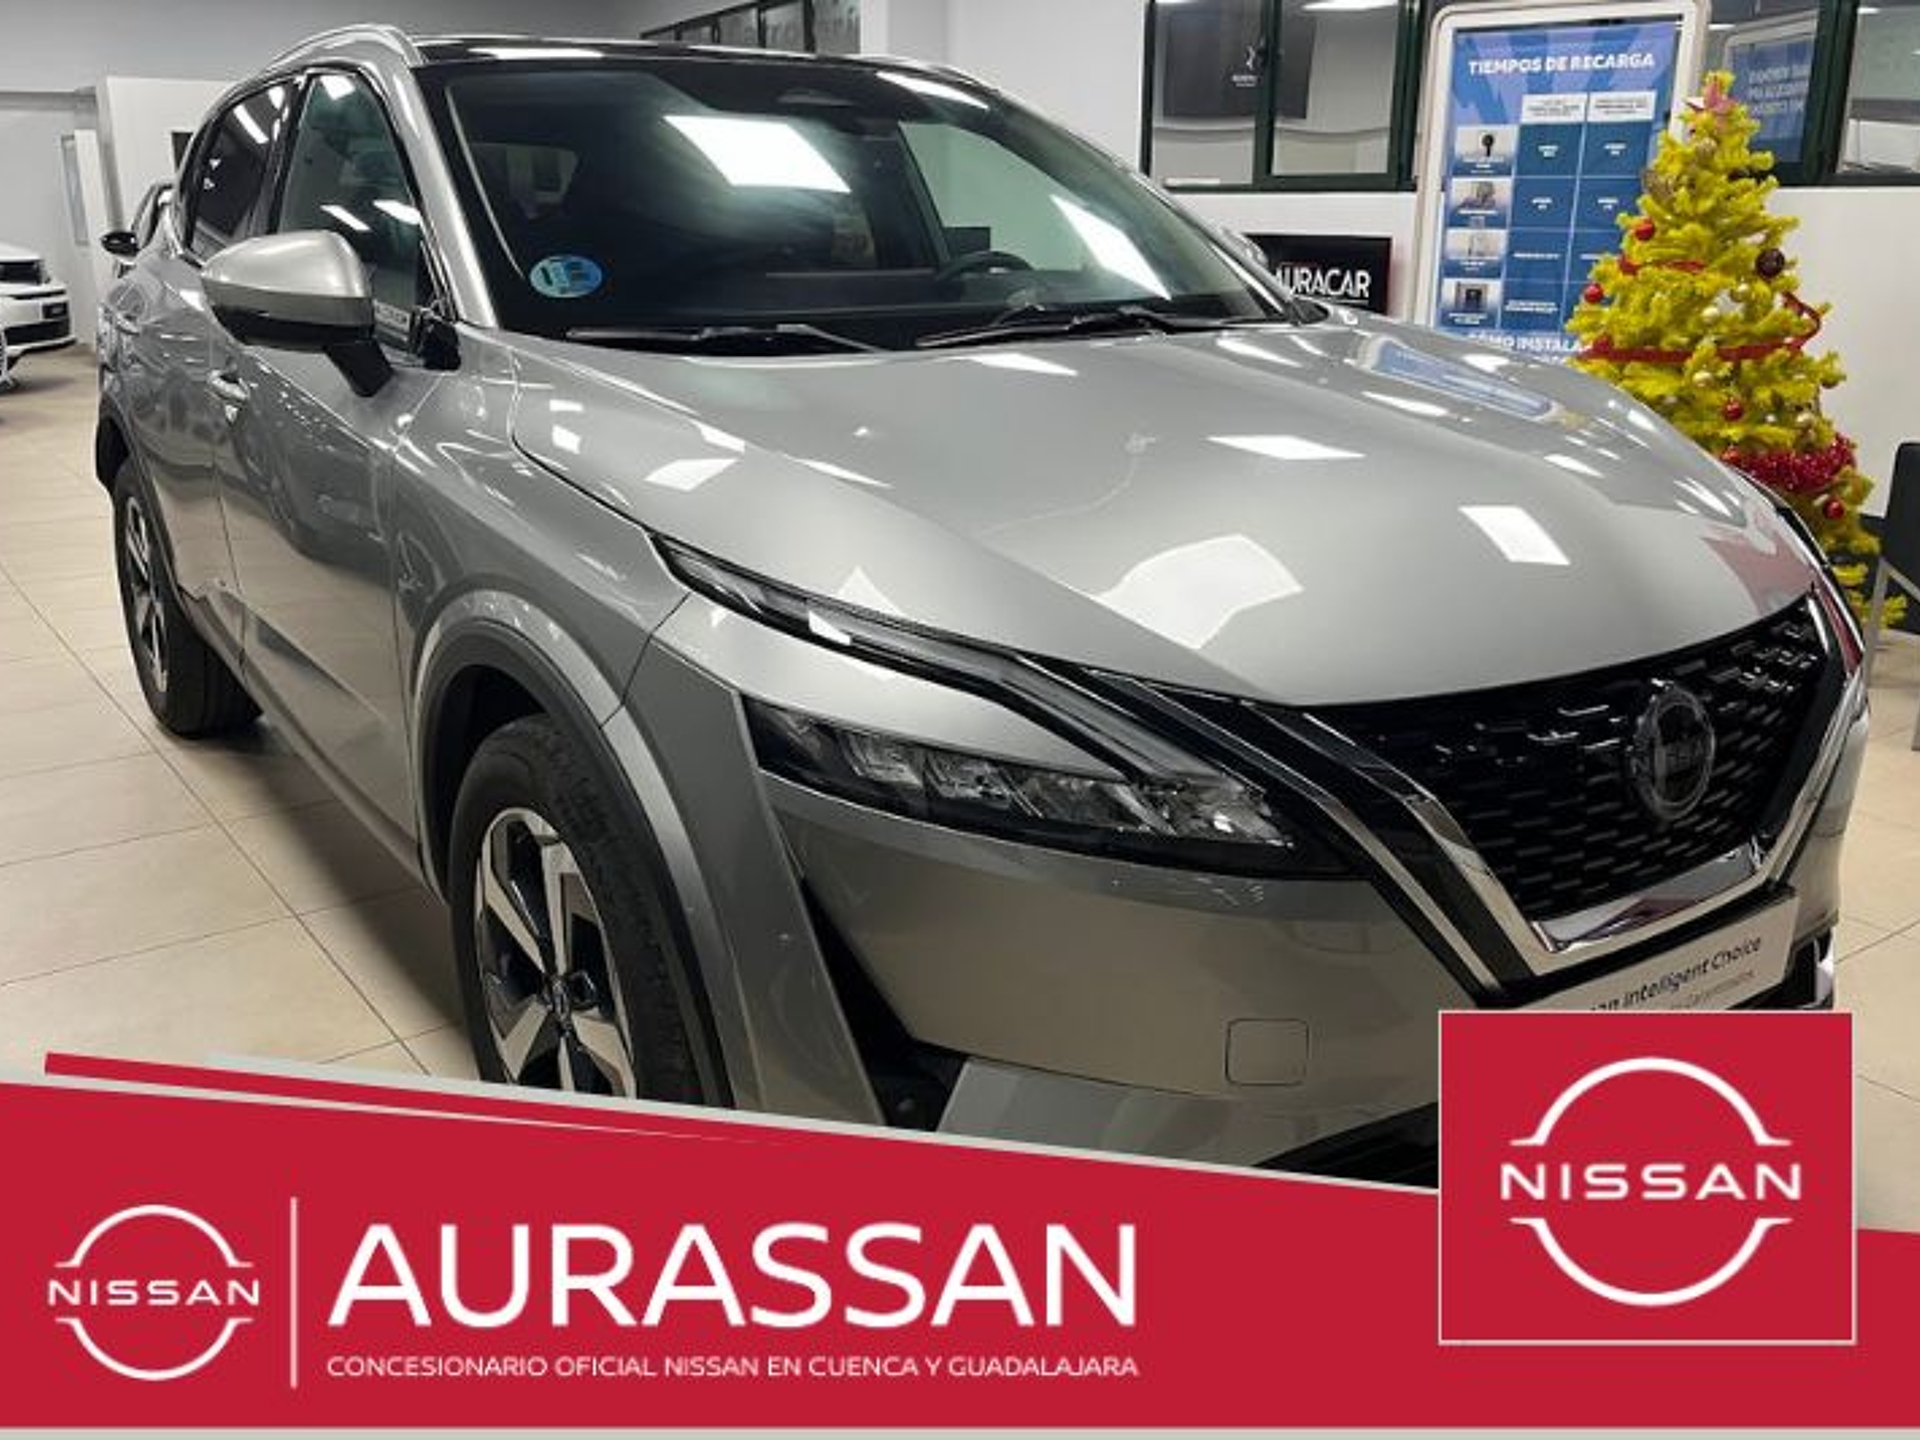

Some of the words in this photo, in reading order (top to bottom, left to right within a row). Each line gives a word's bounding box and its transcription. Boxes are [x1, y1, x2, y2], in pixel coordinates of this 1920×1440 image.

[1468, 56, 1543, 76] TIEMPOS
[1545, 55, 1568, 71] DE
[1570, 53, 1655, 70] RECARGA
[1711, 937, 1762, 971] Choice
